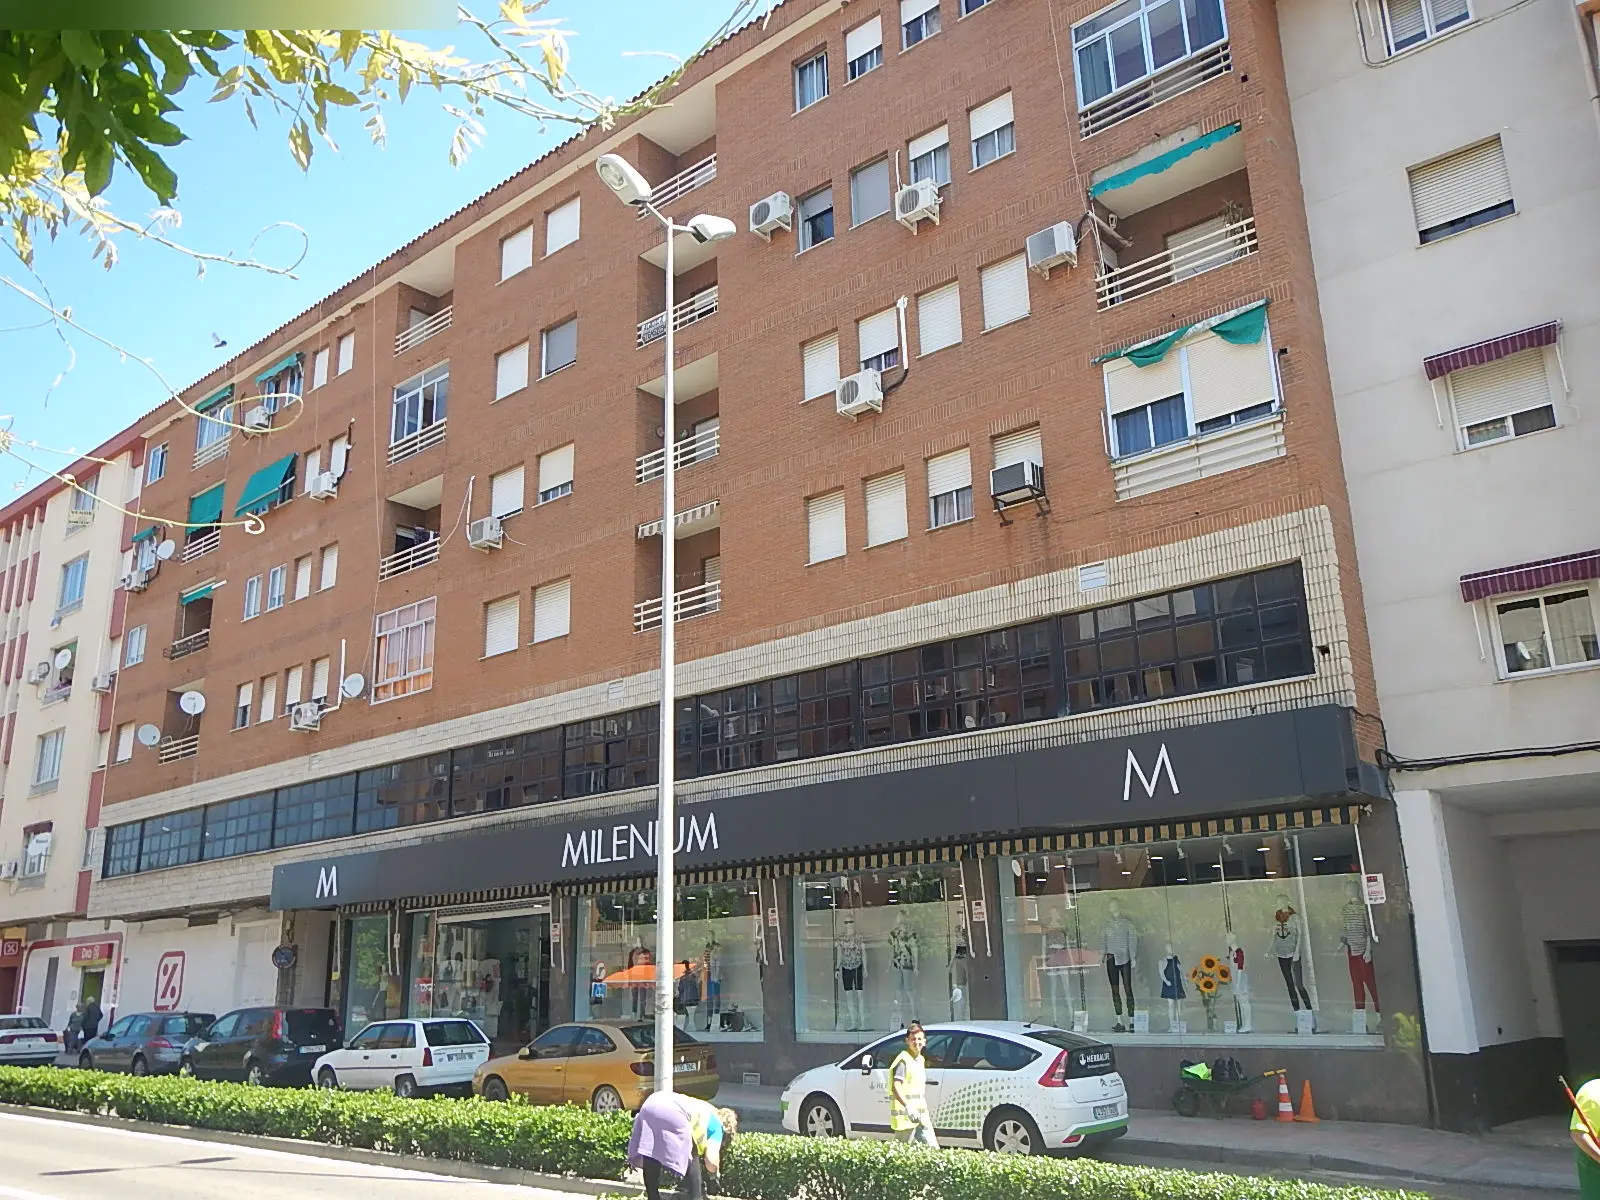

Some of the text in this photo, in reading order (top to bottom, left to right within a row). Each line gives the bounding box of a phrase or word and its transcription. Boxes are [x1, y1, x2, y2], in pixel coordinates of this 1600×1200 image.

[1123, 743, 1180, 801] M
[561, 811, 719, 868] MILENIUM
[315, 865, 338, 899] M
